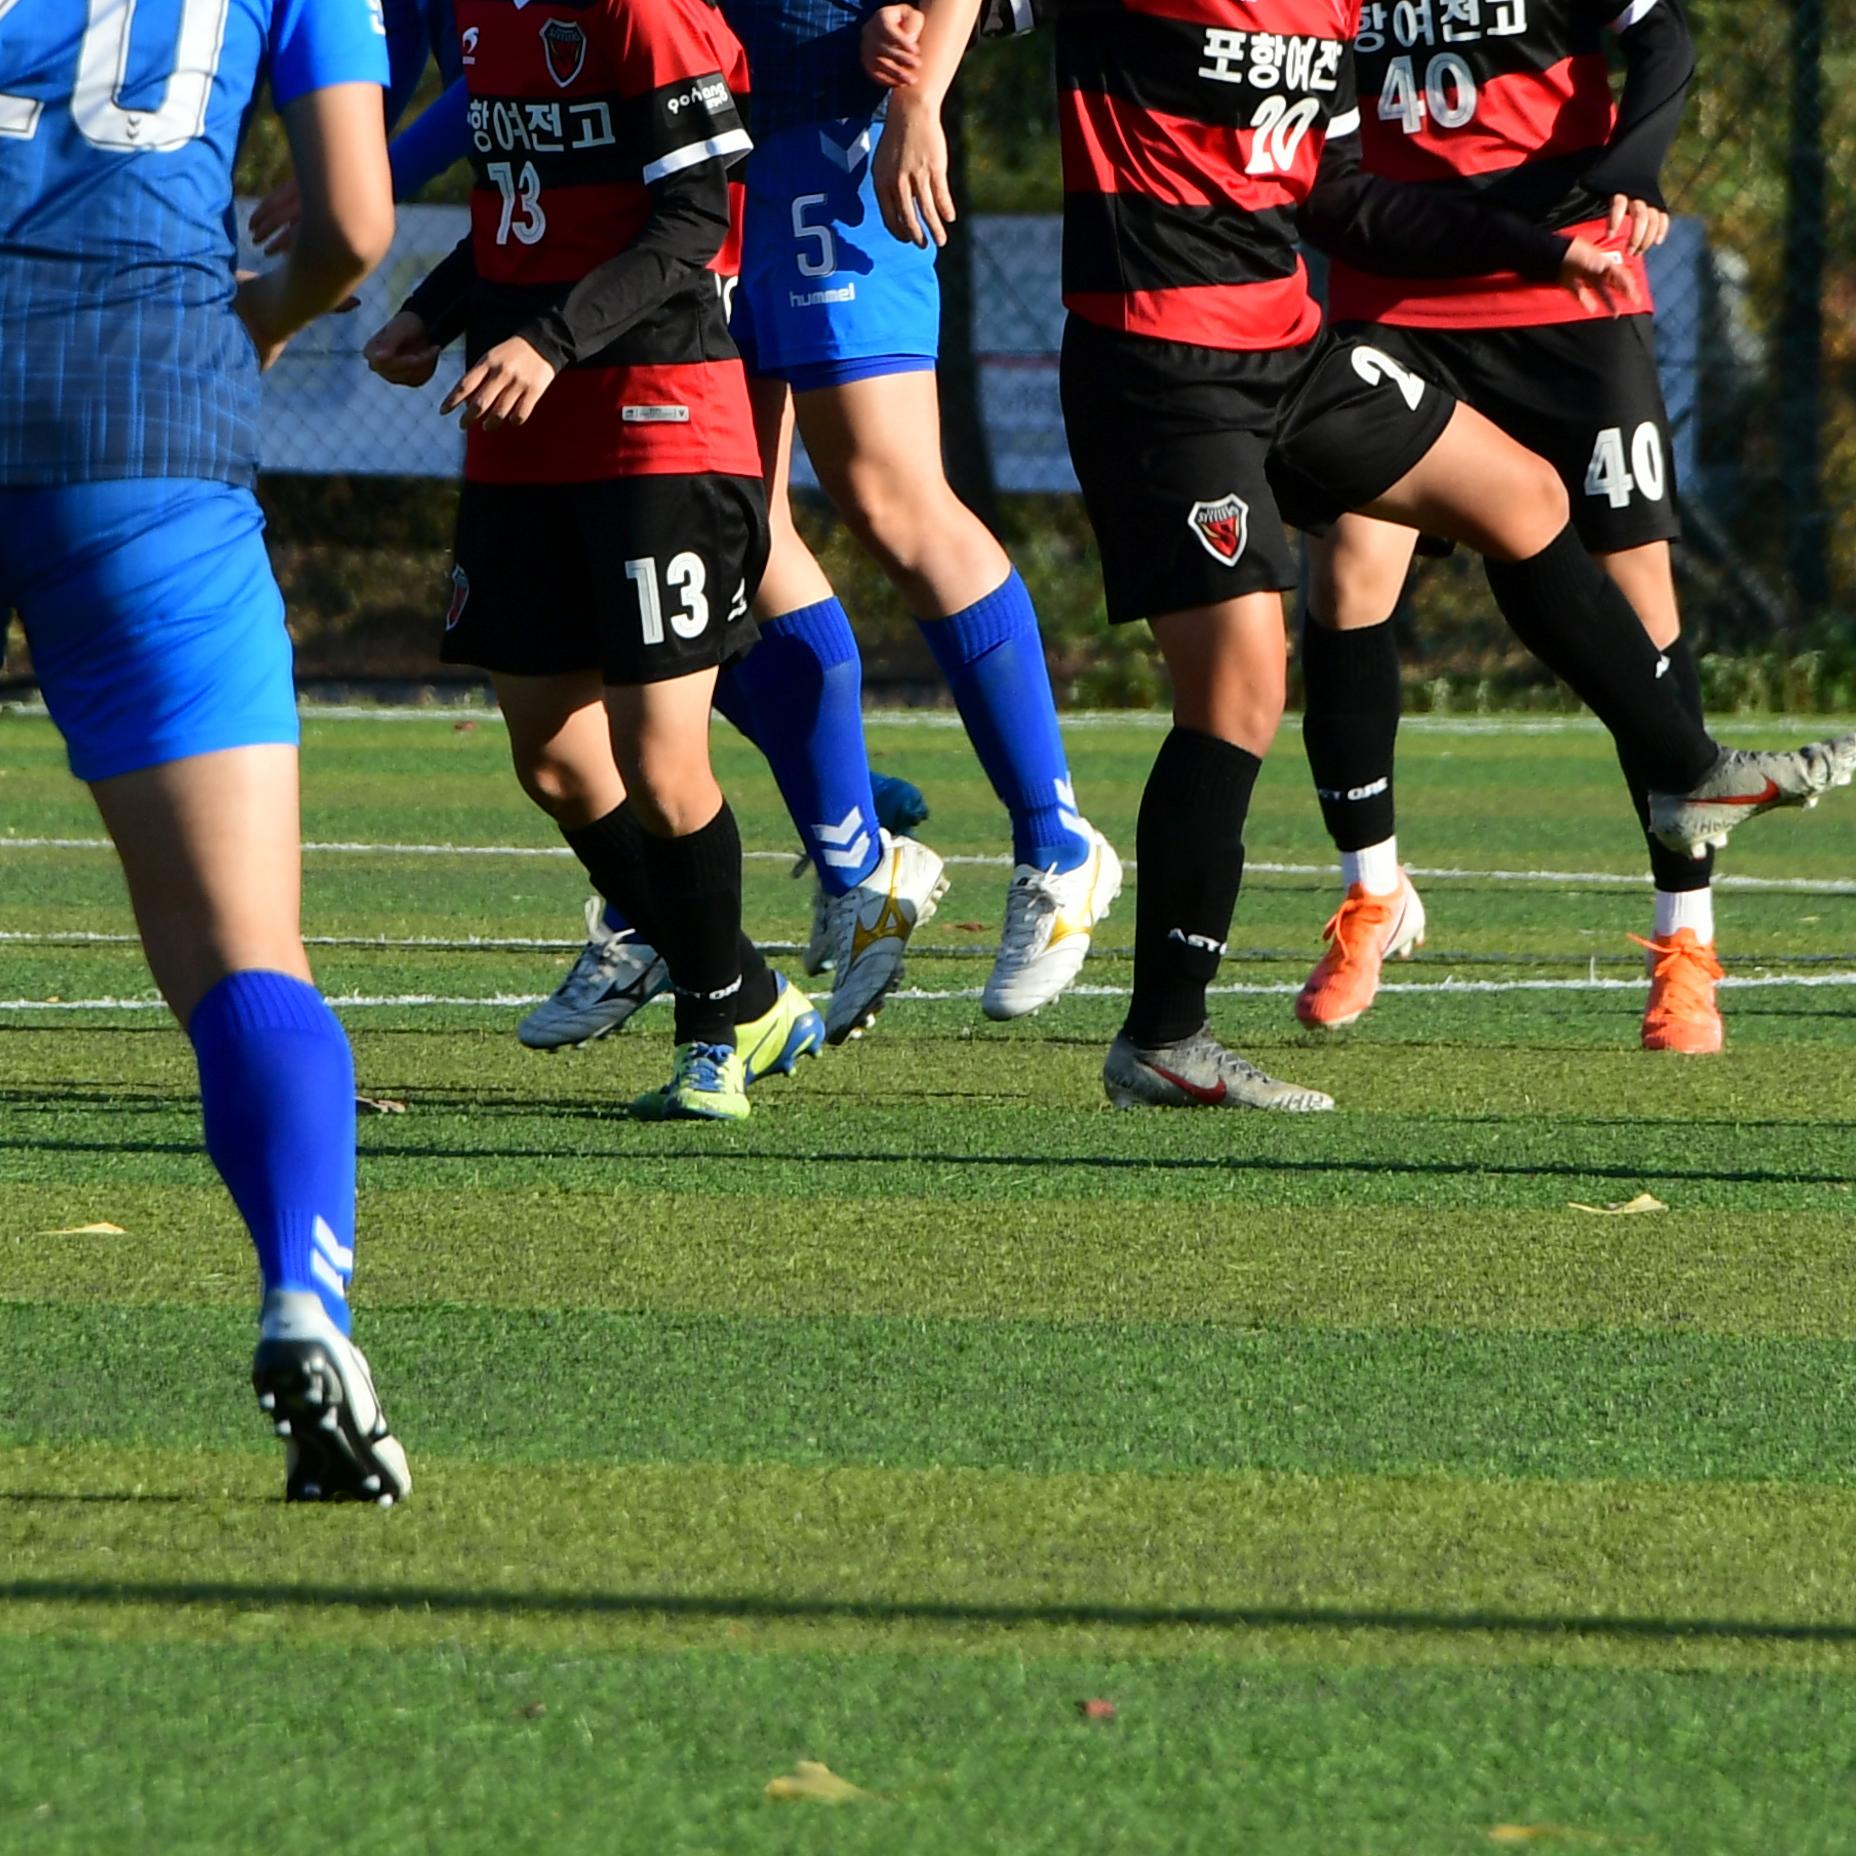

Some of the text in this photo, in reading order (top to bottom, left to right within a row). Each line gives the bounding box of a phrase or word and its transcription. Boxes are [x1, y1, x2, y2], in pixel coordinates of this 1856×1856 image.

[1245, 94, 1320, 174] 20
[1377, 52, 1478, 134] 40
[487, 160, 546, 245] 13
[791, 192, 836, 278] 5
[789, 281, 856, 308] hummel
[1585, 421, 1665, 509] 40
[624, 552, 710, 646] 13
